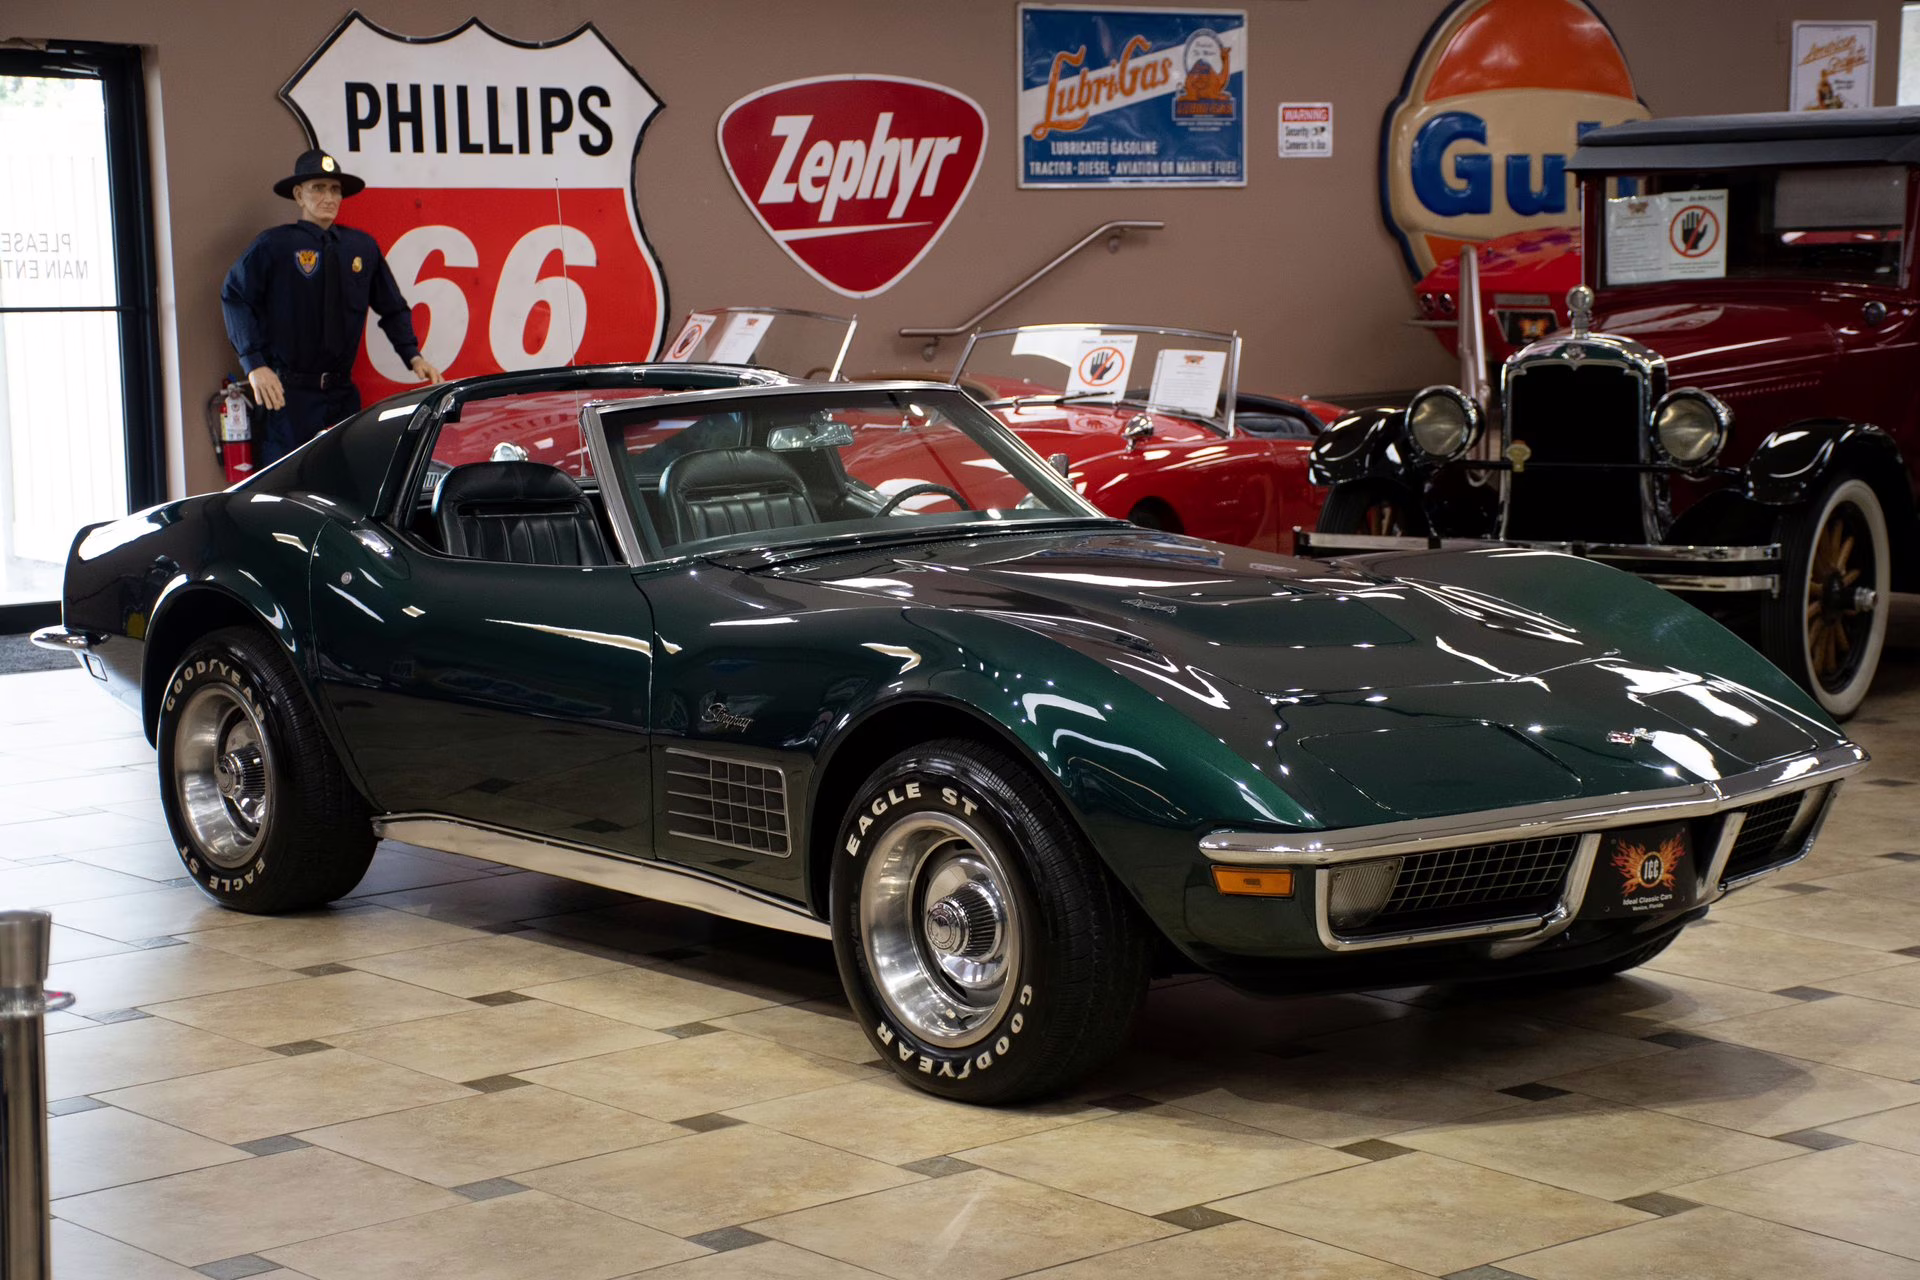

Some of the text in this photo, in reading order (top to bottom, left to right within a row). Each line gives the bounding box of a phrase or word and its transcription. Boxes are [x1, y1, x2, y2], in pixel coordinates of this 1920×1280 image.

[345, 81, 613, 156] PHILLIPS
[1051, 140, 1158, 155] LUBRICATED GASOLINE
[1284, 109, 1327, 121] WARNING
[758, 112, 962, 222] Zephyr
[1161, 161, 1174, 176] OR
[1176, 161, 1213, 176] MARINE
[1214, 161, 1238, 176] FUEL
[1411, 111, 1602, 217] Gu
[365, 224, 598, 384] 66
[165, 658, 266, 725] GOODYEAR
[702, 702, 753, 733] Stingray
[845, 782, 979, 857] EAGLE ST
[179, 844, 267, 893] EAGLE ST
[1623, 898, 1638, 906] Ideal
[1639, 895, 1660, 904] Classic
[876, 984, 1034, 1080] GOODYEAR
